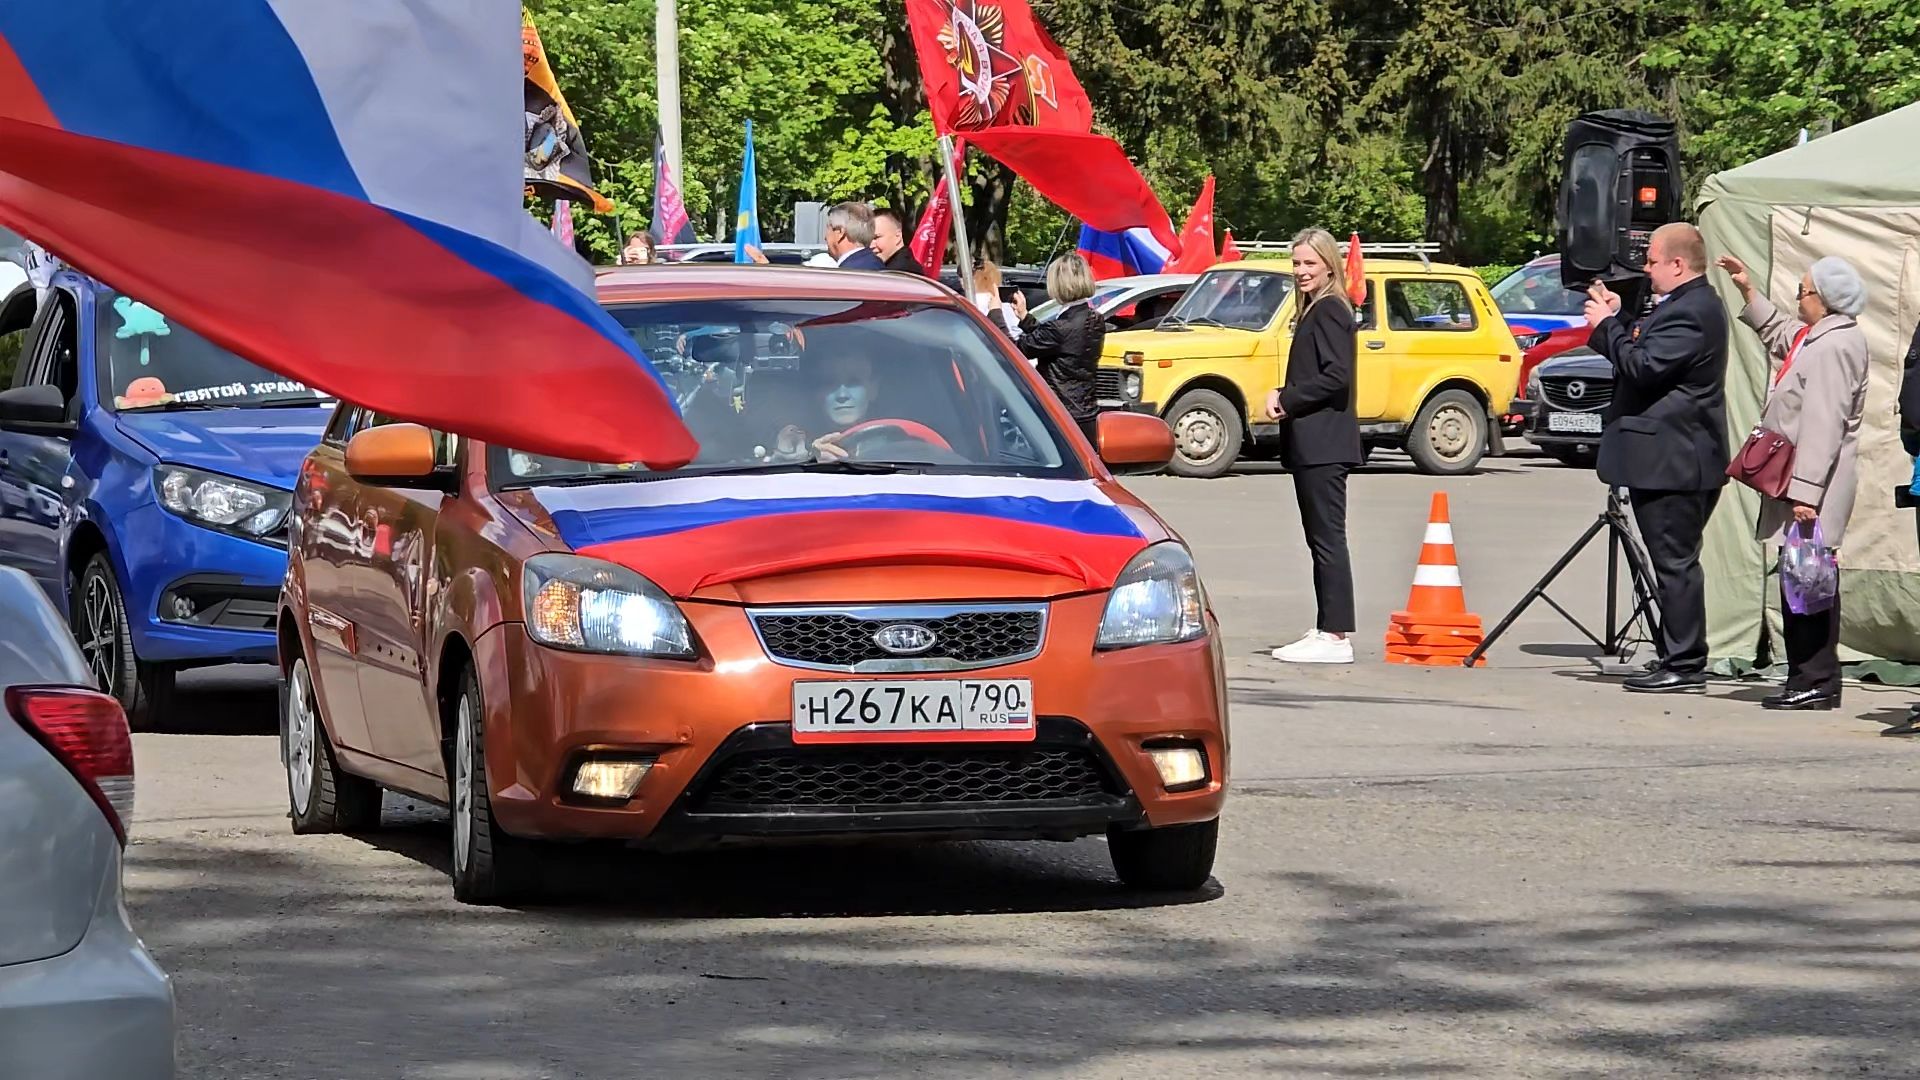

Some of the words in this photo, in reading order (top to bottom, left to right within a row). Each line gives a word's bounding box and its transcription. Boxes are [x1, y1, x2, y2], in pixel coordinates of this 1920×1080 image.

[250, 381, 306, 395] ХРАМ
[965, 683, 1021, 712] 790
[980, 713, 1007, 724] RUS
